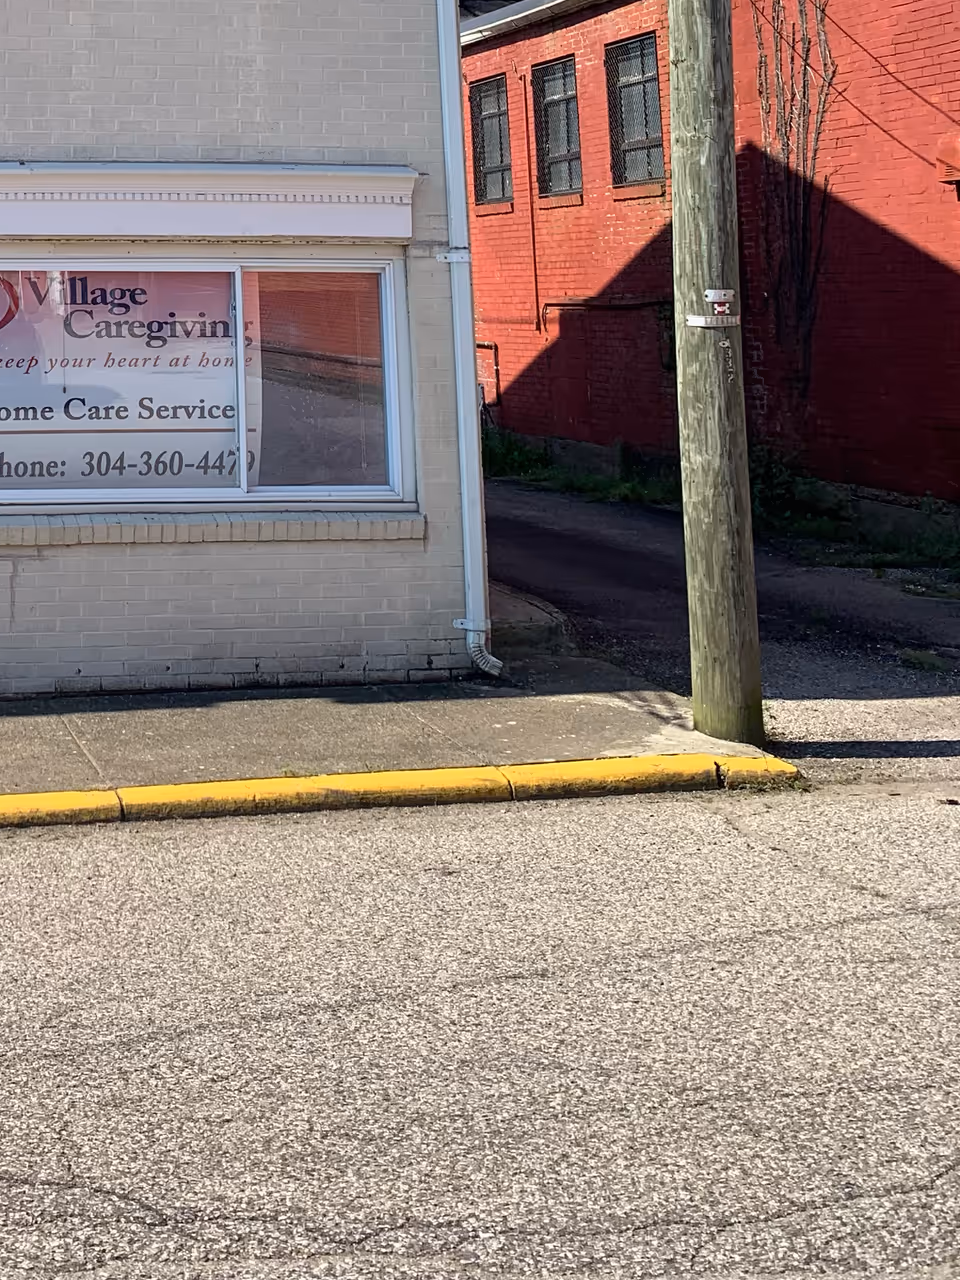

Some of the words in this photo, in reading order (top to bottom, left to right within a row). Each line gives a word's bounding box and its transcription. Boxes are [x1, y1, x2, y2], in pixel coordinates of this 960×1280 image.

[24, 275, 148, 316] Village
[44, 357, 96, 375] your
[103, 352, 161, 368] heart
[168, 354, 191, 368] at
[63, 397, 129, 420] Care
[138, 397, 236, 420] Service
